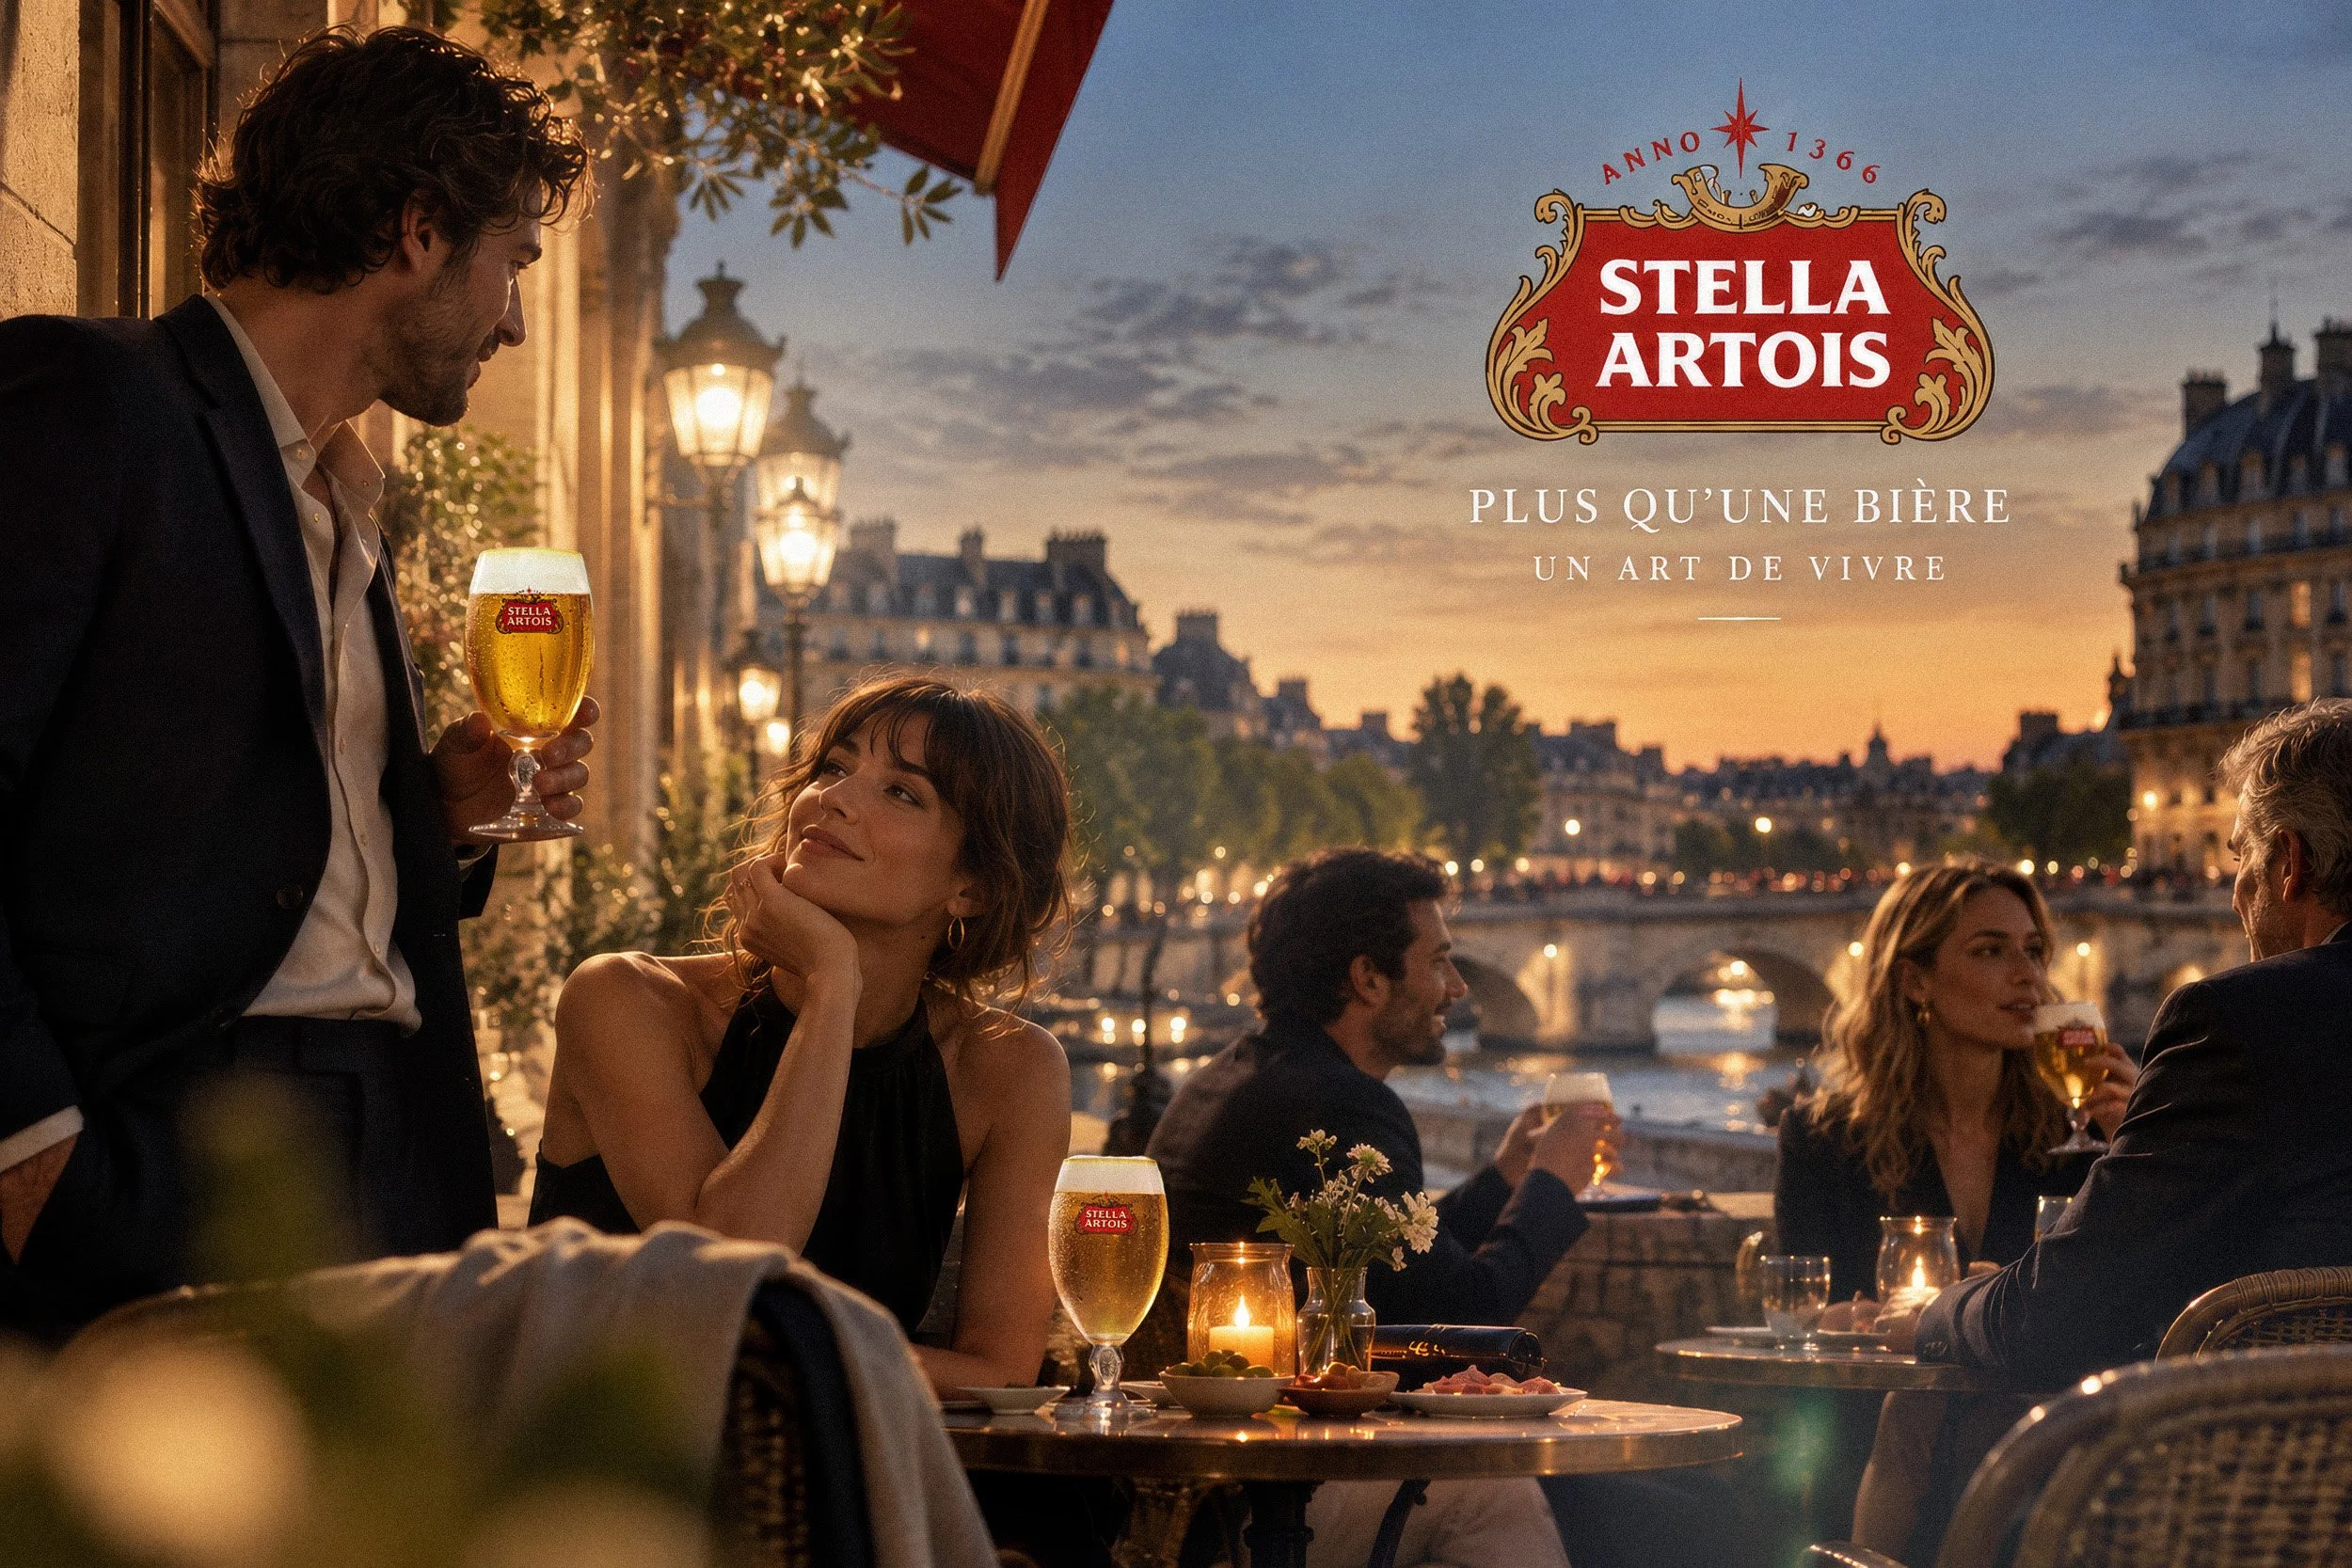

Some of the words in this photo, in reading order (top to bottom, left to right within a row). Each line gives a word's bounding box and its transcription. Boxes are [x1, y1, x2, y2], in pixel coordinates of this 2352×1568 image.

[507, 606, 550, 616] STELLA
[507, 617, 551, 626] ARTOIS
[1086, 1210, 1126, 1219] STELLA
[1085, 1219, 1127, 1228] ARTOIS
